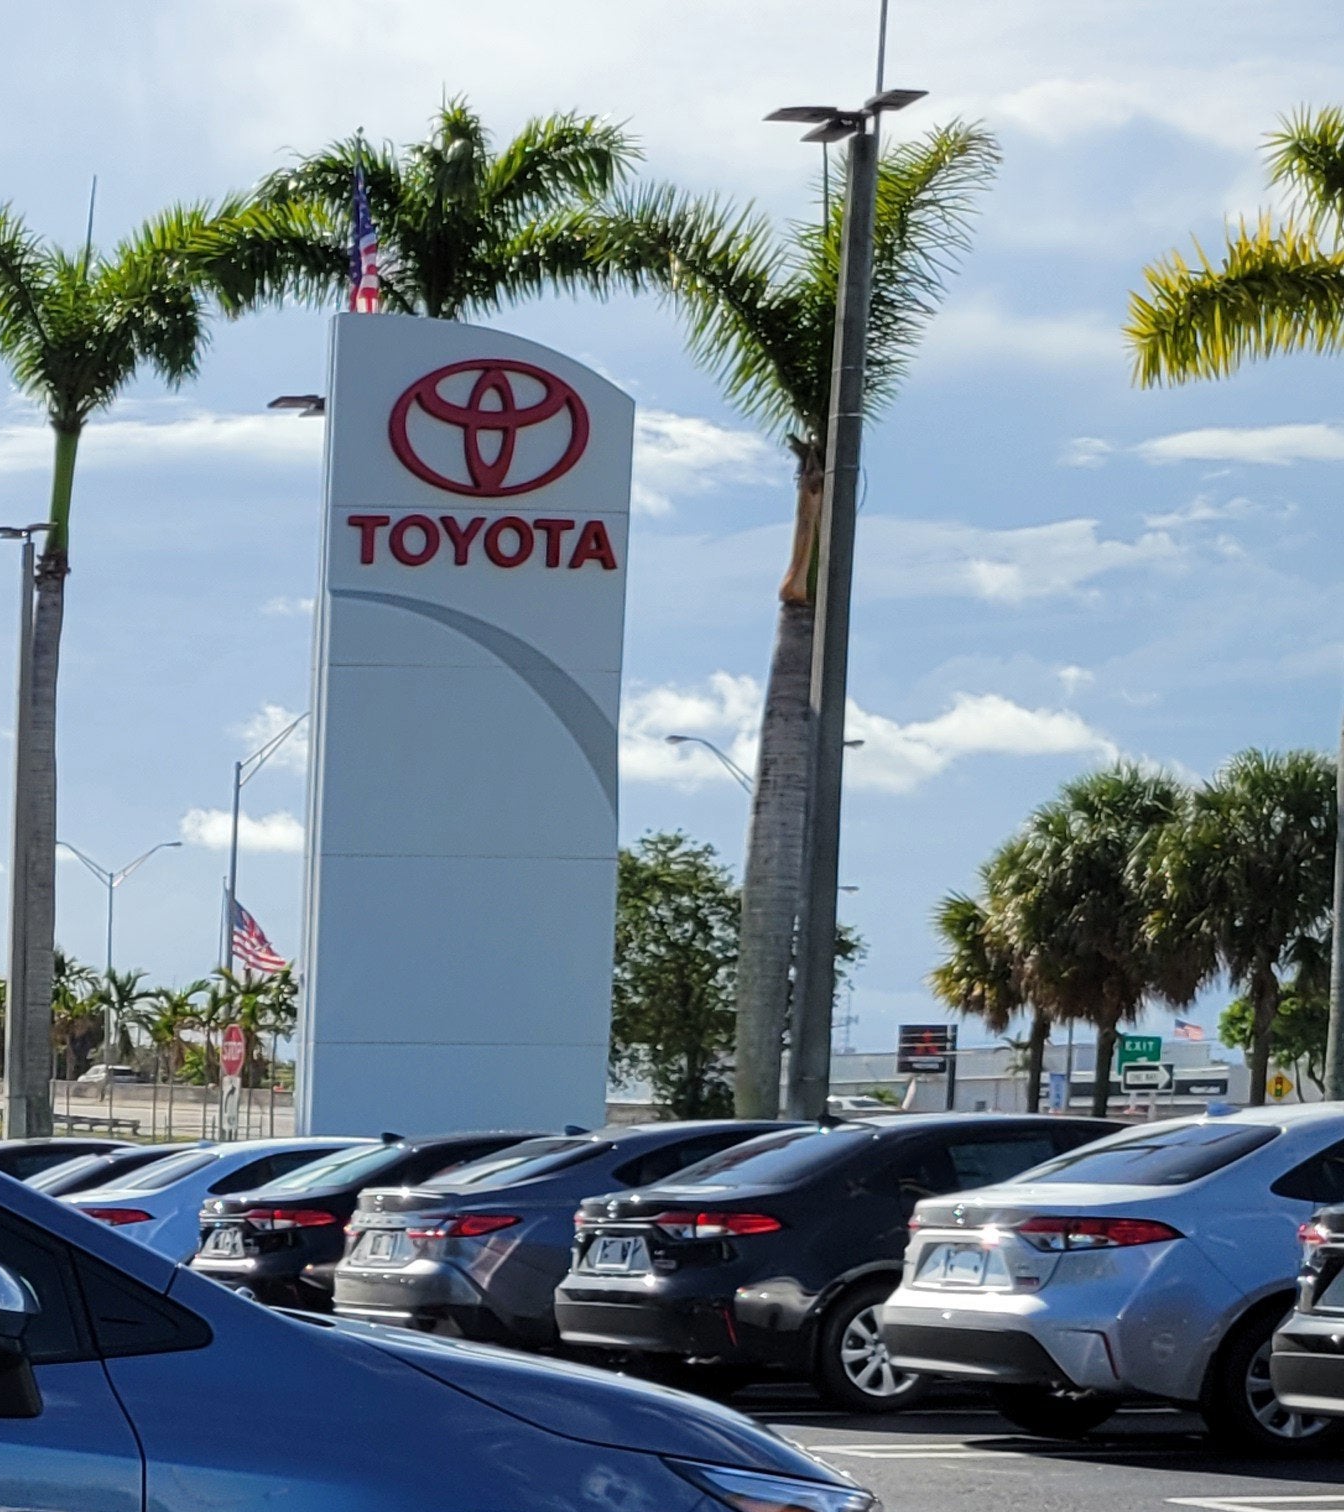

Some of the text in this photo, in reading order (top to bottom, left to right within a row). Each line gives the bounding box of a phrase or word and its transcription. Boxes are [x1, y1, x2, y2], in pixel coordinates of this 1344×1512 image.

[348, 514, 618, 570] TOYOTA
[222, 1041, 243, 1061] STOP
[1124, 1041, 1154, 1052] EXIT
